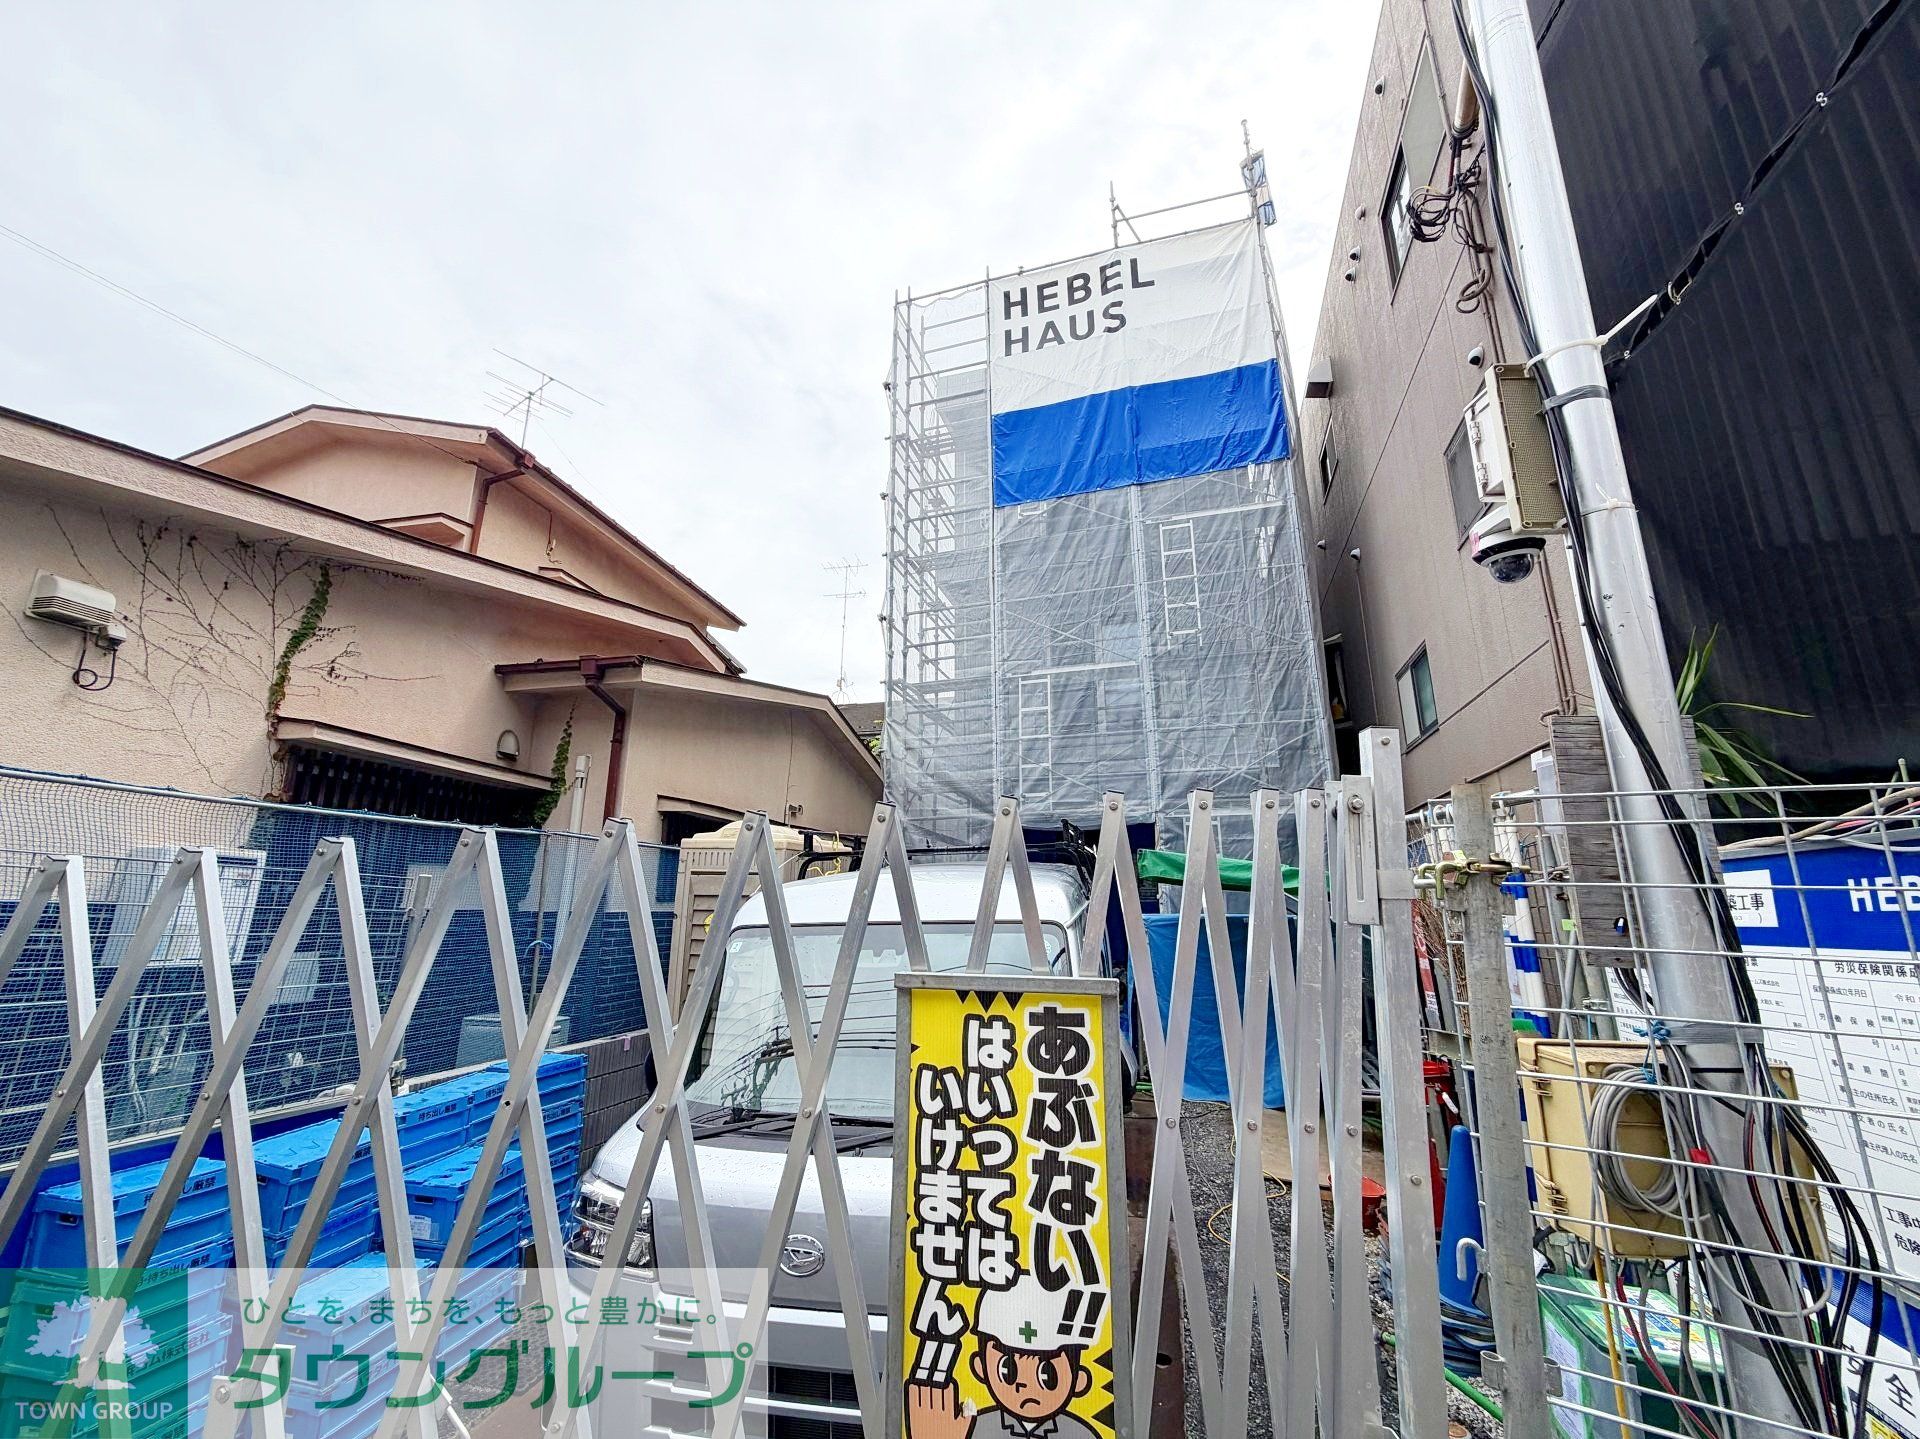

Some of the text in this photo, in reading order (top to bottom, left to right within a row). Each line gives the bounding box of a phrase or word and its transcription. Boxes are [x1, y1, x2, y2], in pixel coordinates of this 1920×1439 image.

[1003, 258, 1155, 320] HEBEL
[1004, 300, 1127, 356] HAUS
[966, 1017, 1017, 1287] はいっては
